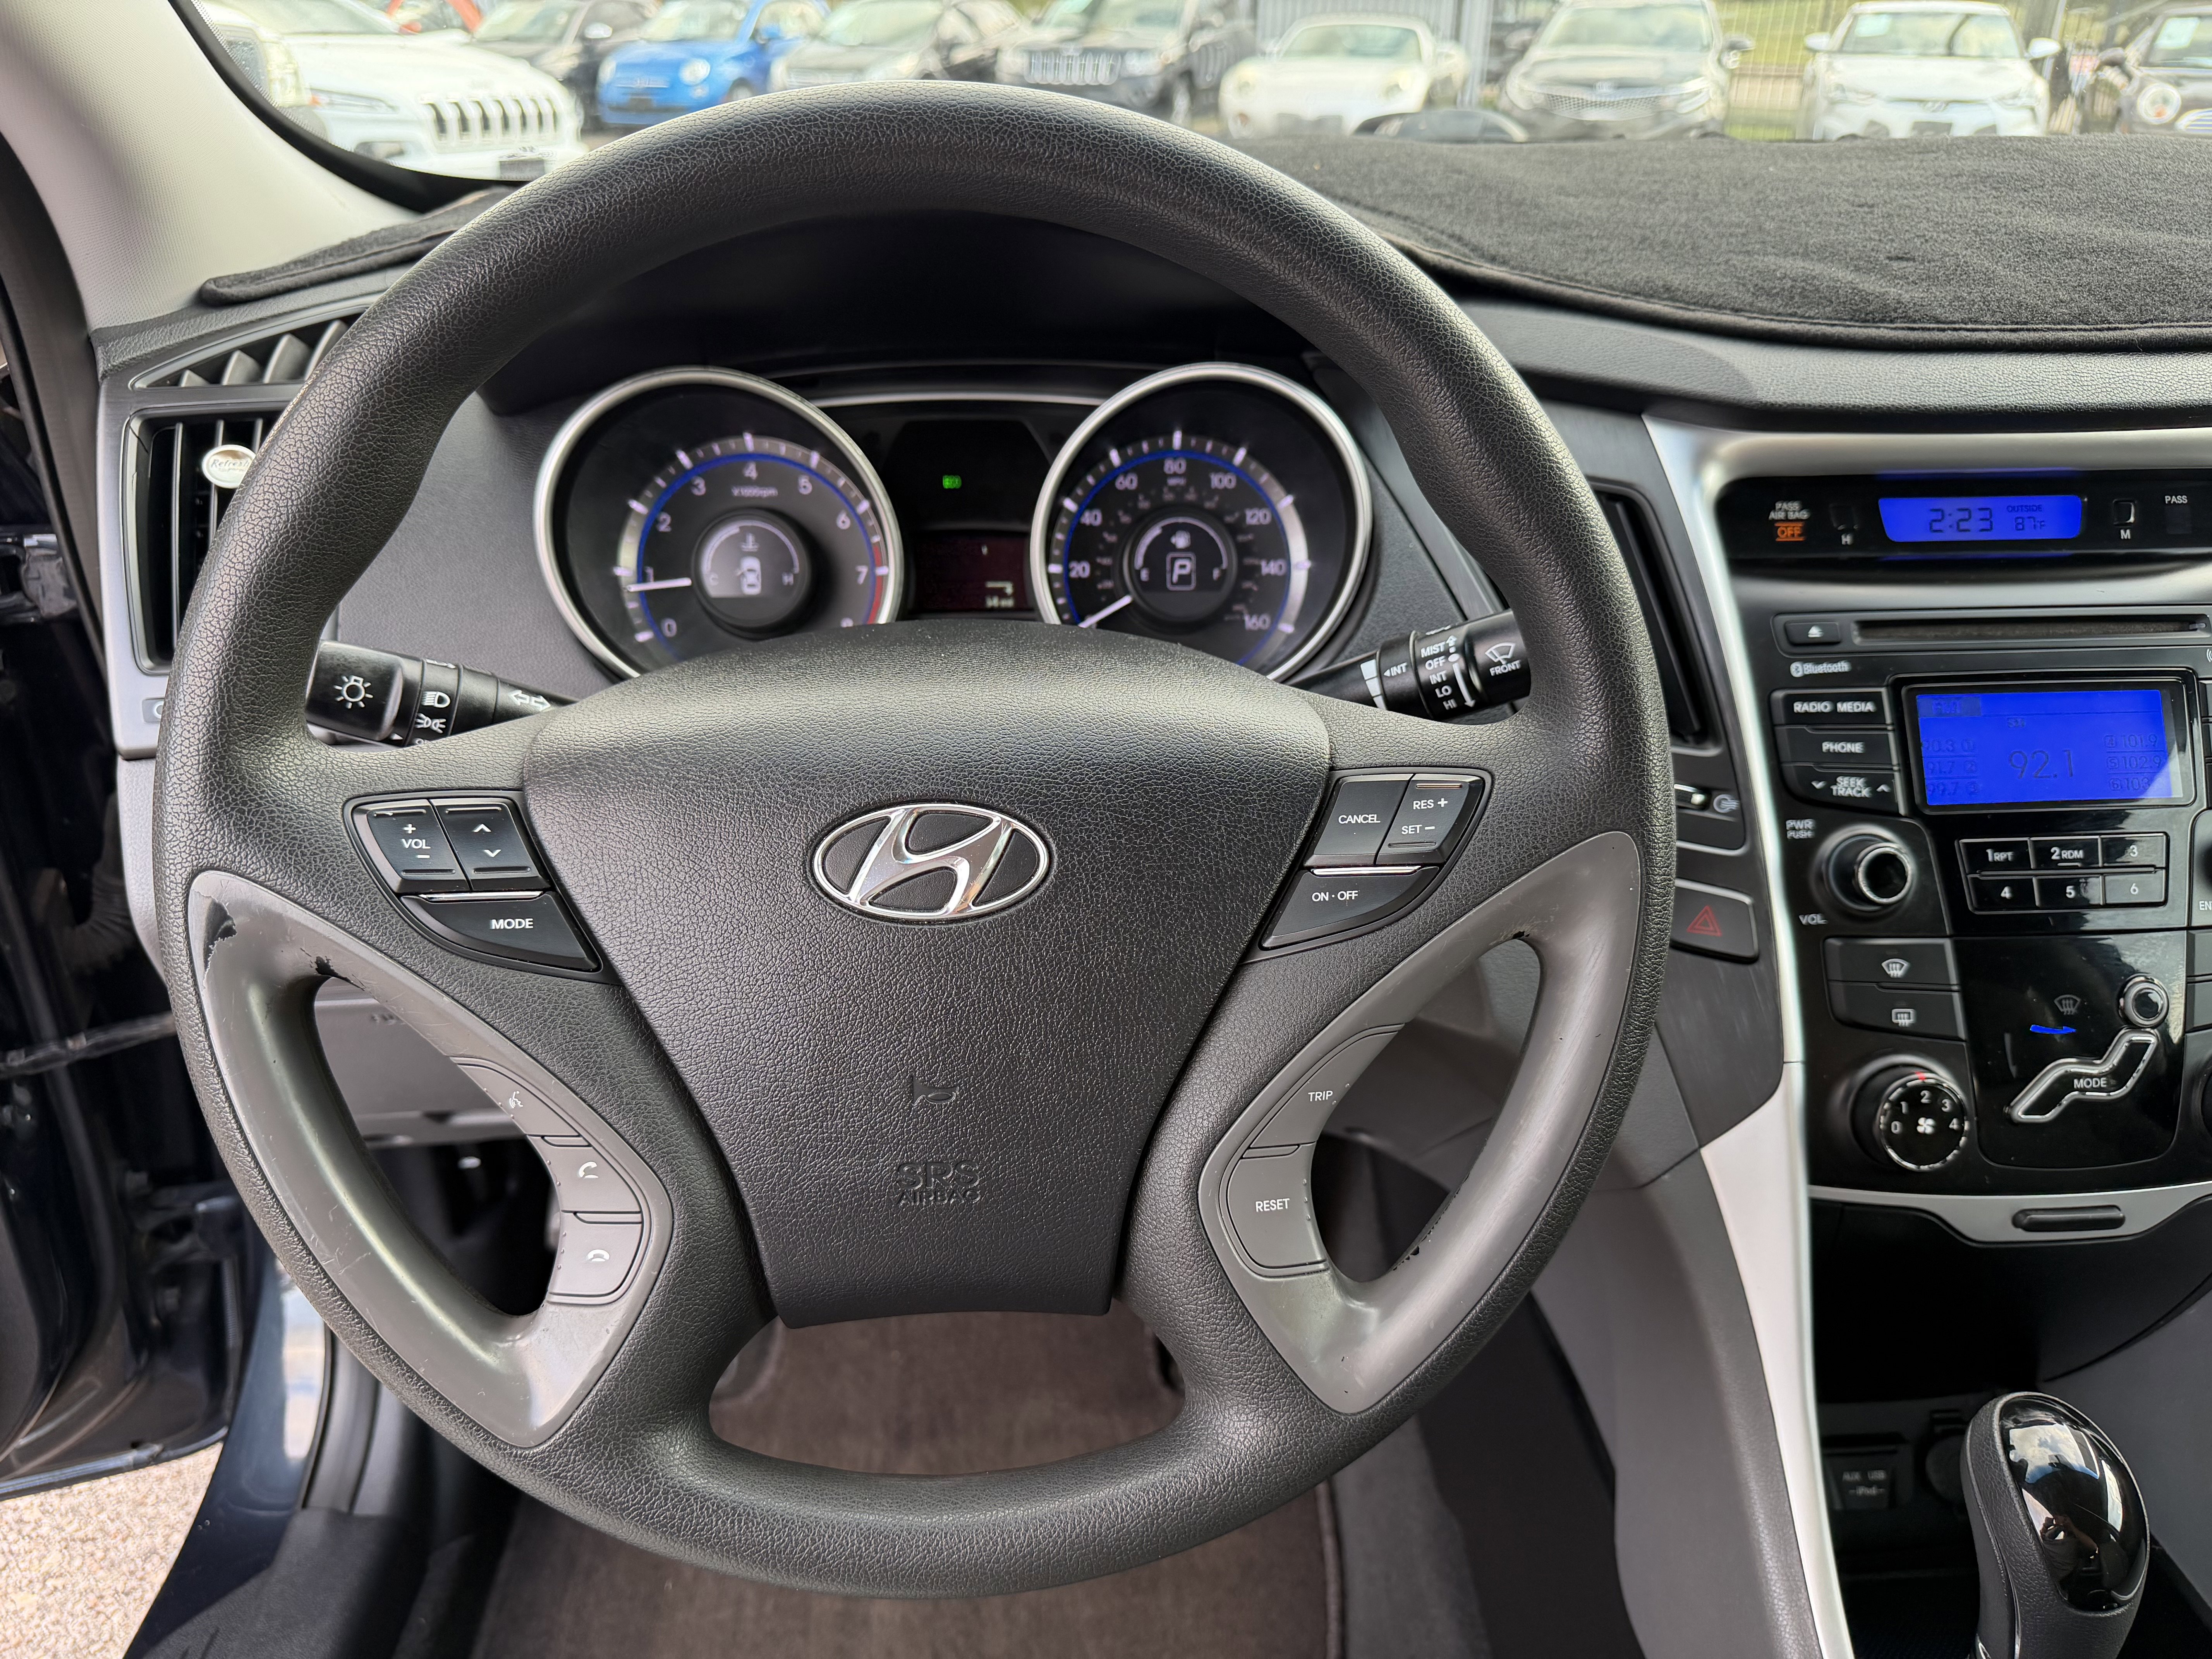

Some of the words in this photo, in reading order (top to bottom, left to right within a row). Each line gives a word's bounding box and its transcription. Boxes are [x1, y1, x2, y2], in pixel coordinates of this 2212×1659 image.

[743, 463, 757, 479] 4
[1164, 459, 1186, 474] 80
[692, 477, 706, 495] 3
[798, 476, 812, 494] 5
[1115, 473, 1138, 490] 60
[1209, 472, 1237, 489] 100
[1776, 500, 1802, 511] PASS
[2165, 495, 2188, 504] PASS
[1769, 510, 1786, 520] AIR
[1788, 509, 1812, 519] BAG
[2007, 504, 2042, 513] OUTSIDE
[837, 512, 851, 530] 6
[1080, 509, 1102, 526] 40
[1245, 508, 1272, 525] 120
[1929, 508, 1993, 533] 2:23
[658, 515, 672, 532] 2
[1777, 527, 1803, 538] OFF
[1841, 533, 1854, 545] H
[2120, 529, 2130, 539] M
[1069, 561, 1090, 579] 20
[1172, 558, 1192, 584] P
[1261, 559, 1286, 576] 140
[645, 567, 655, 582] 1
[855, 566, 868, 584] 7
[663, 618, 677, 637] 0
[1244, 613, 1271, 630] 160
[1421, 641, 1446, 658] MIST
[1425, 656, 1446, 670] OFF
[1490, 659, 1521, 676] FRONT
[1803, 660, 1852, 674] Bluetooth
[1391, 663, 1407, 677] INT
[1429, 671, 1447, 684] INT
[1435, 685, 1452, 697] LO
[1443, 699, 1456, 709] HI
[1793, 701, 1834, 713] RADIO
[1837, 701, 1877, 713] MEDIA
[1822, 742, 1866, 753] PHONE
[2009, 749, 2075, 779] 92.1
[1836, 776, 1867, 787] SEEK
[1831, 785, 1873, 798] TRACK
[1413, 799, 1434, 810] RES
[1338, 814, 1381, 824] CANCEL
[1786, 819, 1816, 830] PWR
[1401, 824, 1422, 835] SET
[402, 839, 431, 849] VOL
[2130, 845, 2138, 857] 3
[2001, 886, 2012, 899] 4
[2066, 886, 2075, 898] 5
[2130, 883, 2138, 895] 6
[1312, 891, 1329, 902] ON
[1338, 890, 1358, 900] OFF
[2199, 901, 2212, 910] EN
[491, 918, 534, 929] MODE
[1798, 913, 1828, 926] VOL
[2074, 1077, 2107, 1089] MODE
[1308, 1090, 1333, 1101] TRIP
[1921, 1090, 1932, 1104] 2
[1901, 1101, 1908, 1113] 1
[1941, 1099, 1952, 1112] 3
[1891, 1120, 1902, 1134] 0
[1949, 1118, 1960, 1131] 4
[897, 1162, 980, 1189] SRS
[1255, 1198, 1290, 1212] RESET
